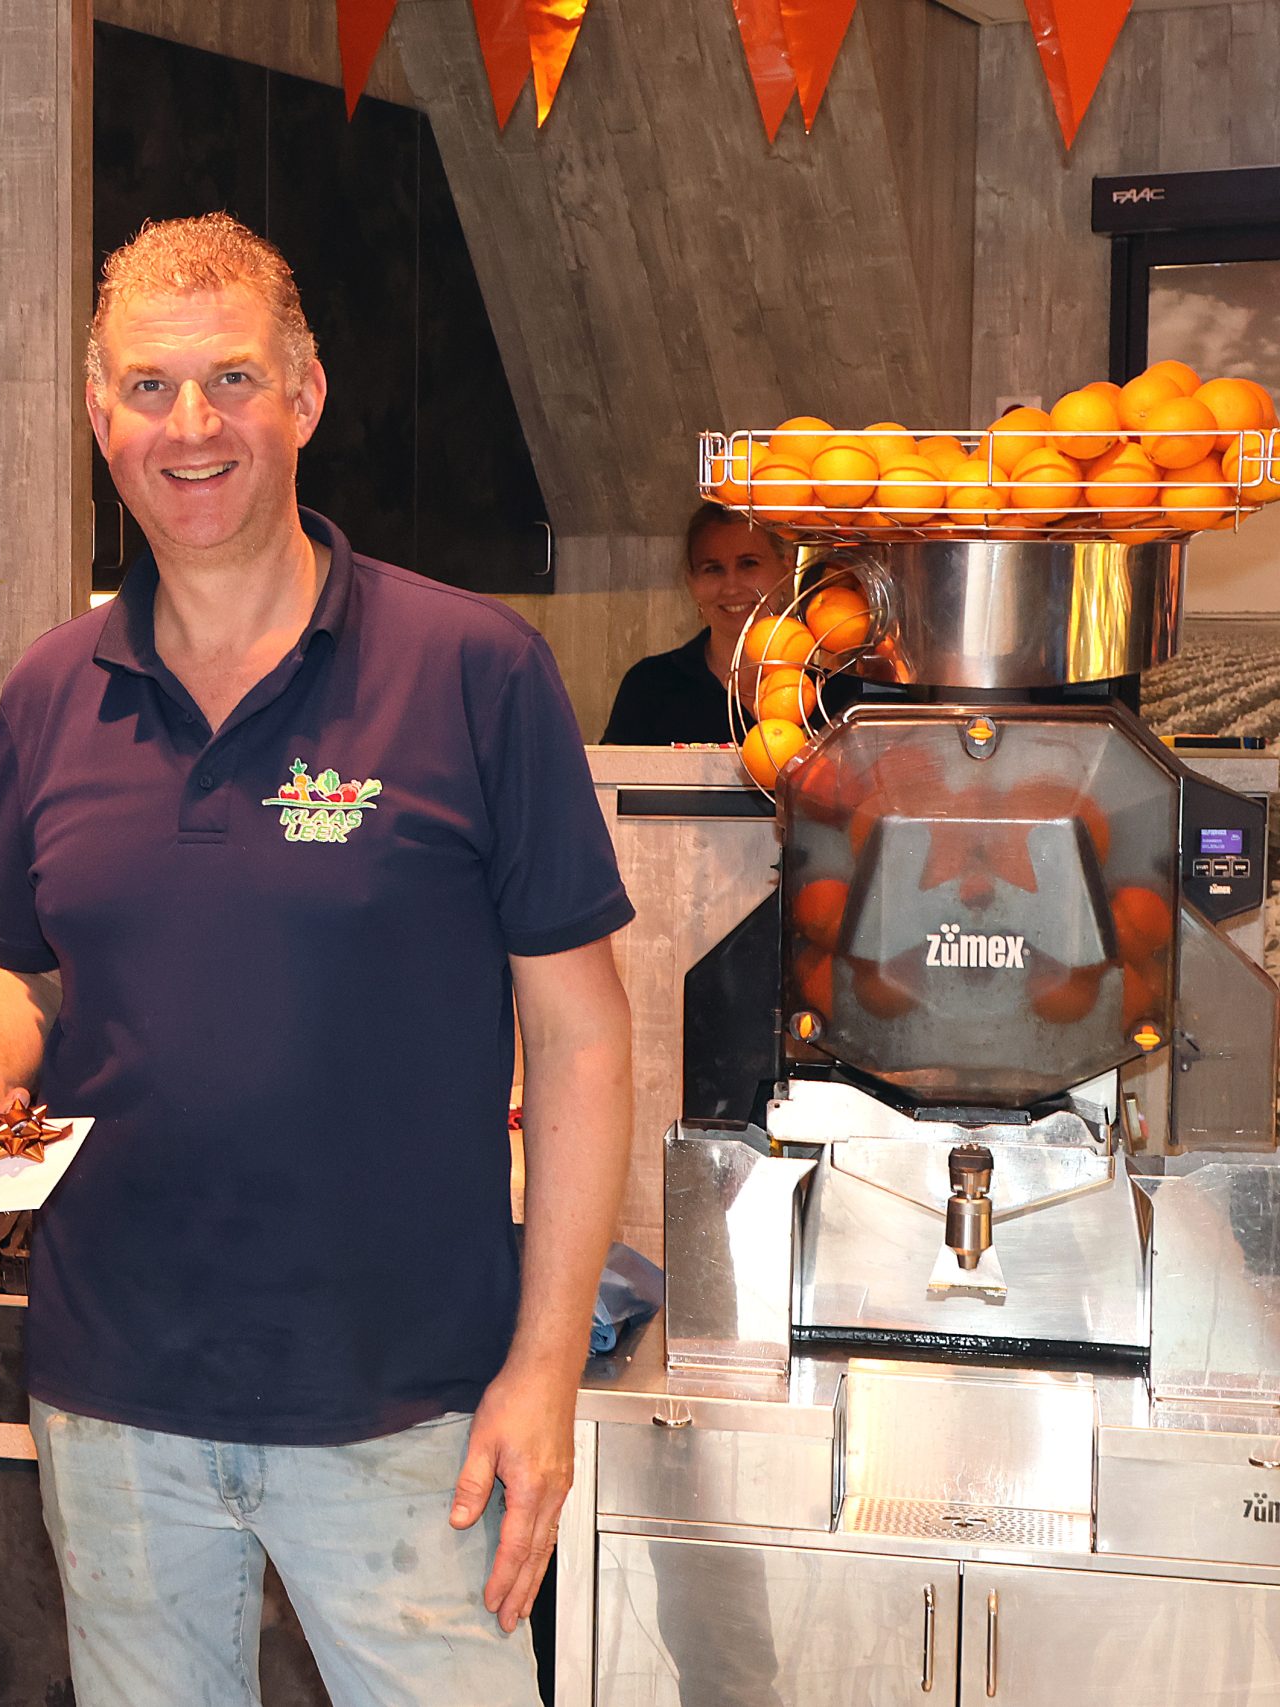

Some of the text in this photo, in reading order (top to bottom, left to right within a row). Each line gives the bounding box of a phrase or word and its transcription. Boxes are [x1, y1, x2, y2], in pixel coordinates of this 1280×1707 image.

[1112, 187, 1165, 204] FAAC
[279, 807, 363, 828] KLAAS
[284, 823, 351, 843] LEEK
[926, 924, 1025, 969] zümex
